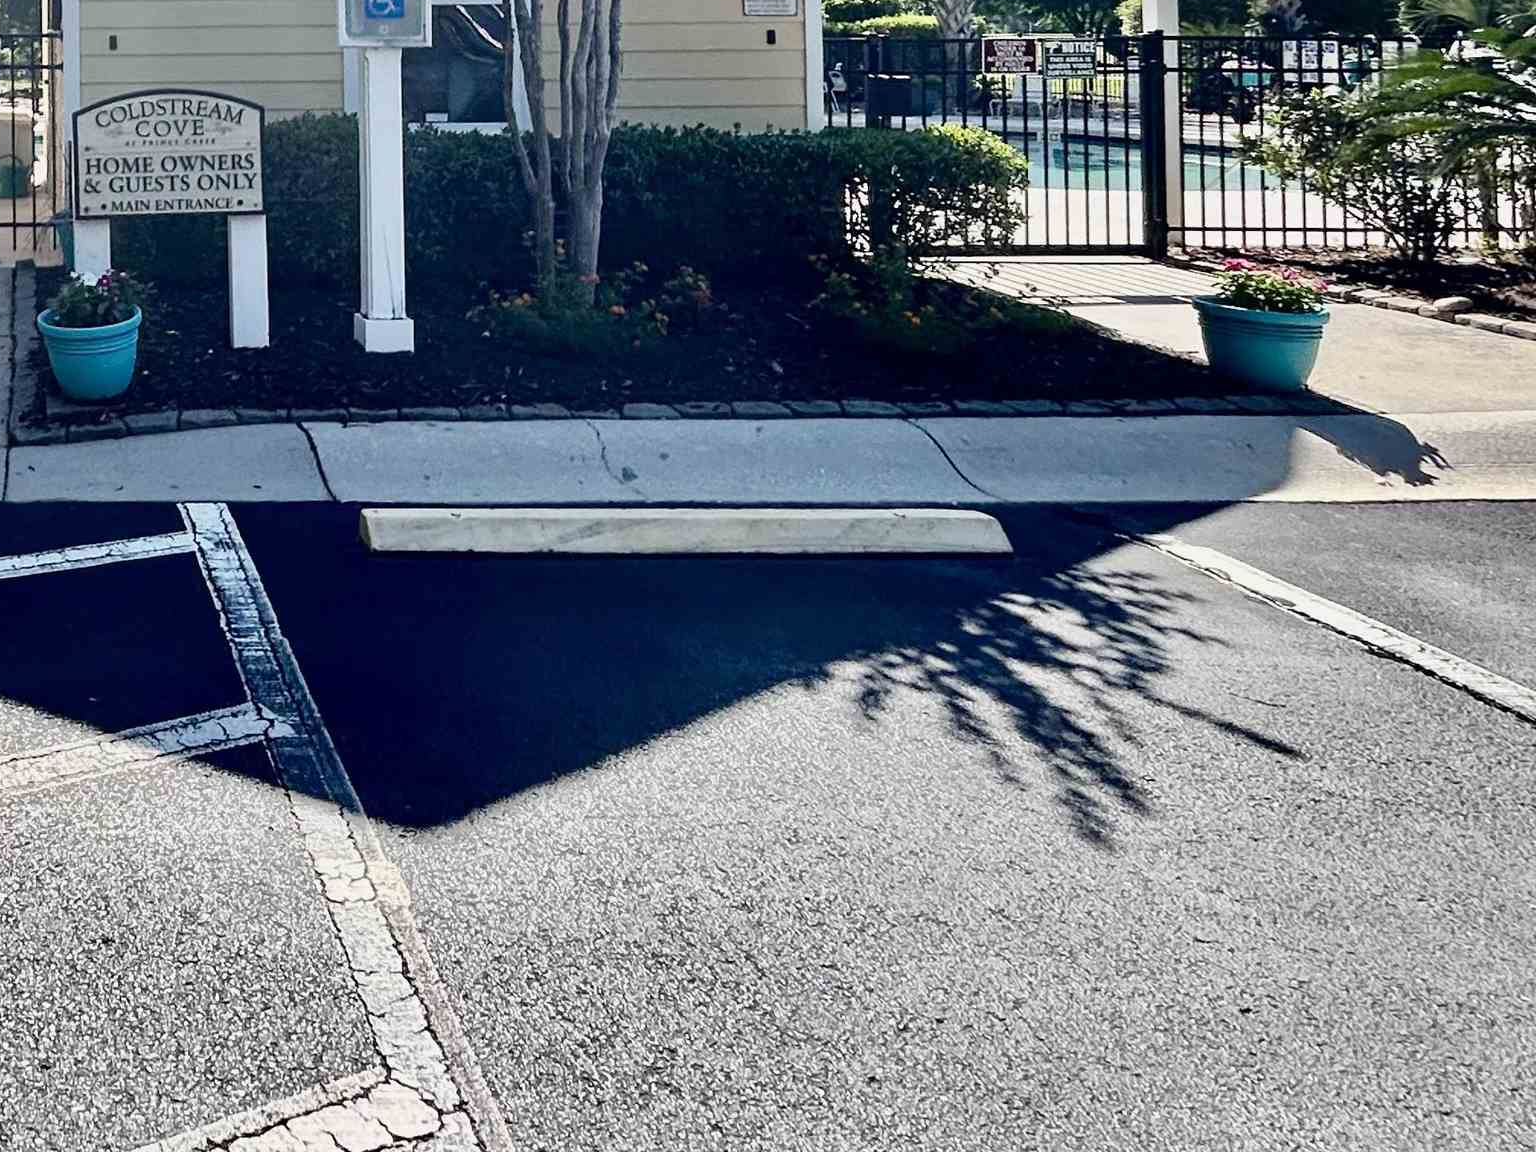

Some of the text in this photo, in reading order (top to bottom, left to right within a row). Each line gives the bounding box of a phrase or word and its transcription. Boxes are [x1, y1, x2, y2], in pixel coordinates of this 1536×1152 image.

[1062, 41, 1095, 53] NOTICE
[95, 99, 244, 127] COLDSTREAM
[135, 119, 205, 138] COVE
[84, 153, 255, 175] HOME OWNERS
[83, 173, 257, 194] & GUESTS ONLY
[111, 197, 234, 212] MAIN ENTRANCE
